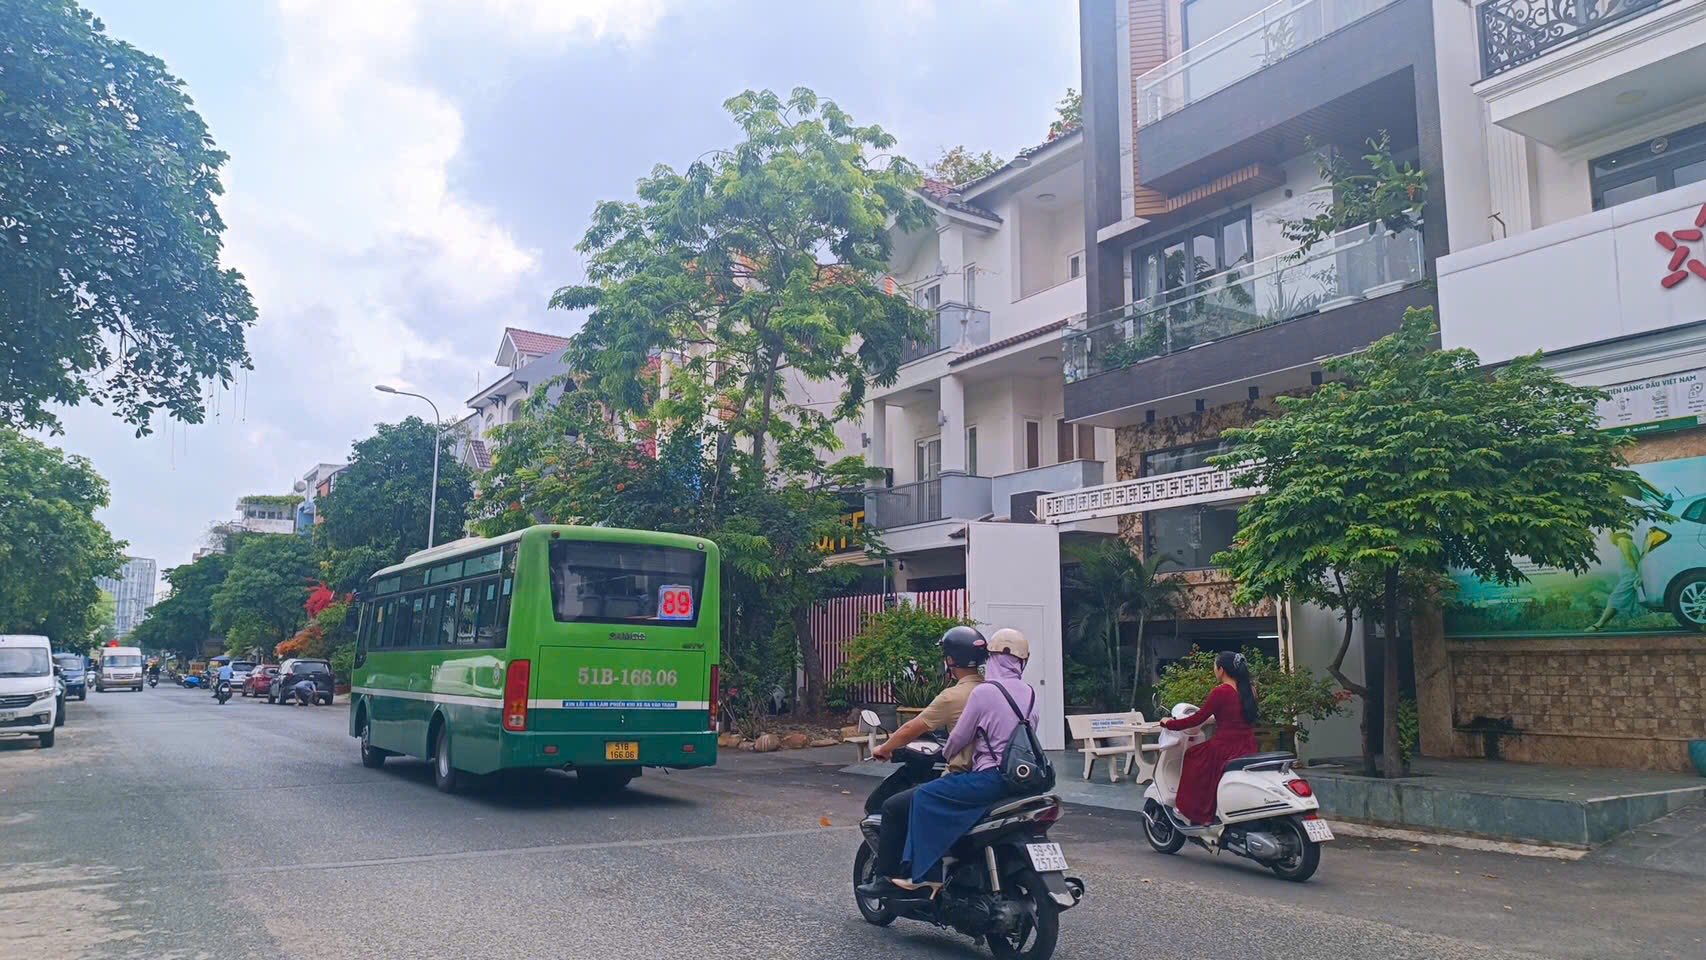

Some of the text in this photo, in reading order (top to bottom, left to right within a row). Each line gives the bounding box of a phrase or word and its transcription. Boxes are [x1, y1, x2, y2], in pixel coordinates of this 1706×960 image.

[1679, 375, 1697, 384] NAM
[663, 591, 690, 615] 89
[578, 667, 678, 686] 51B-166.06
